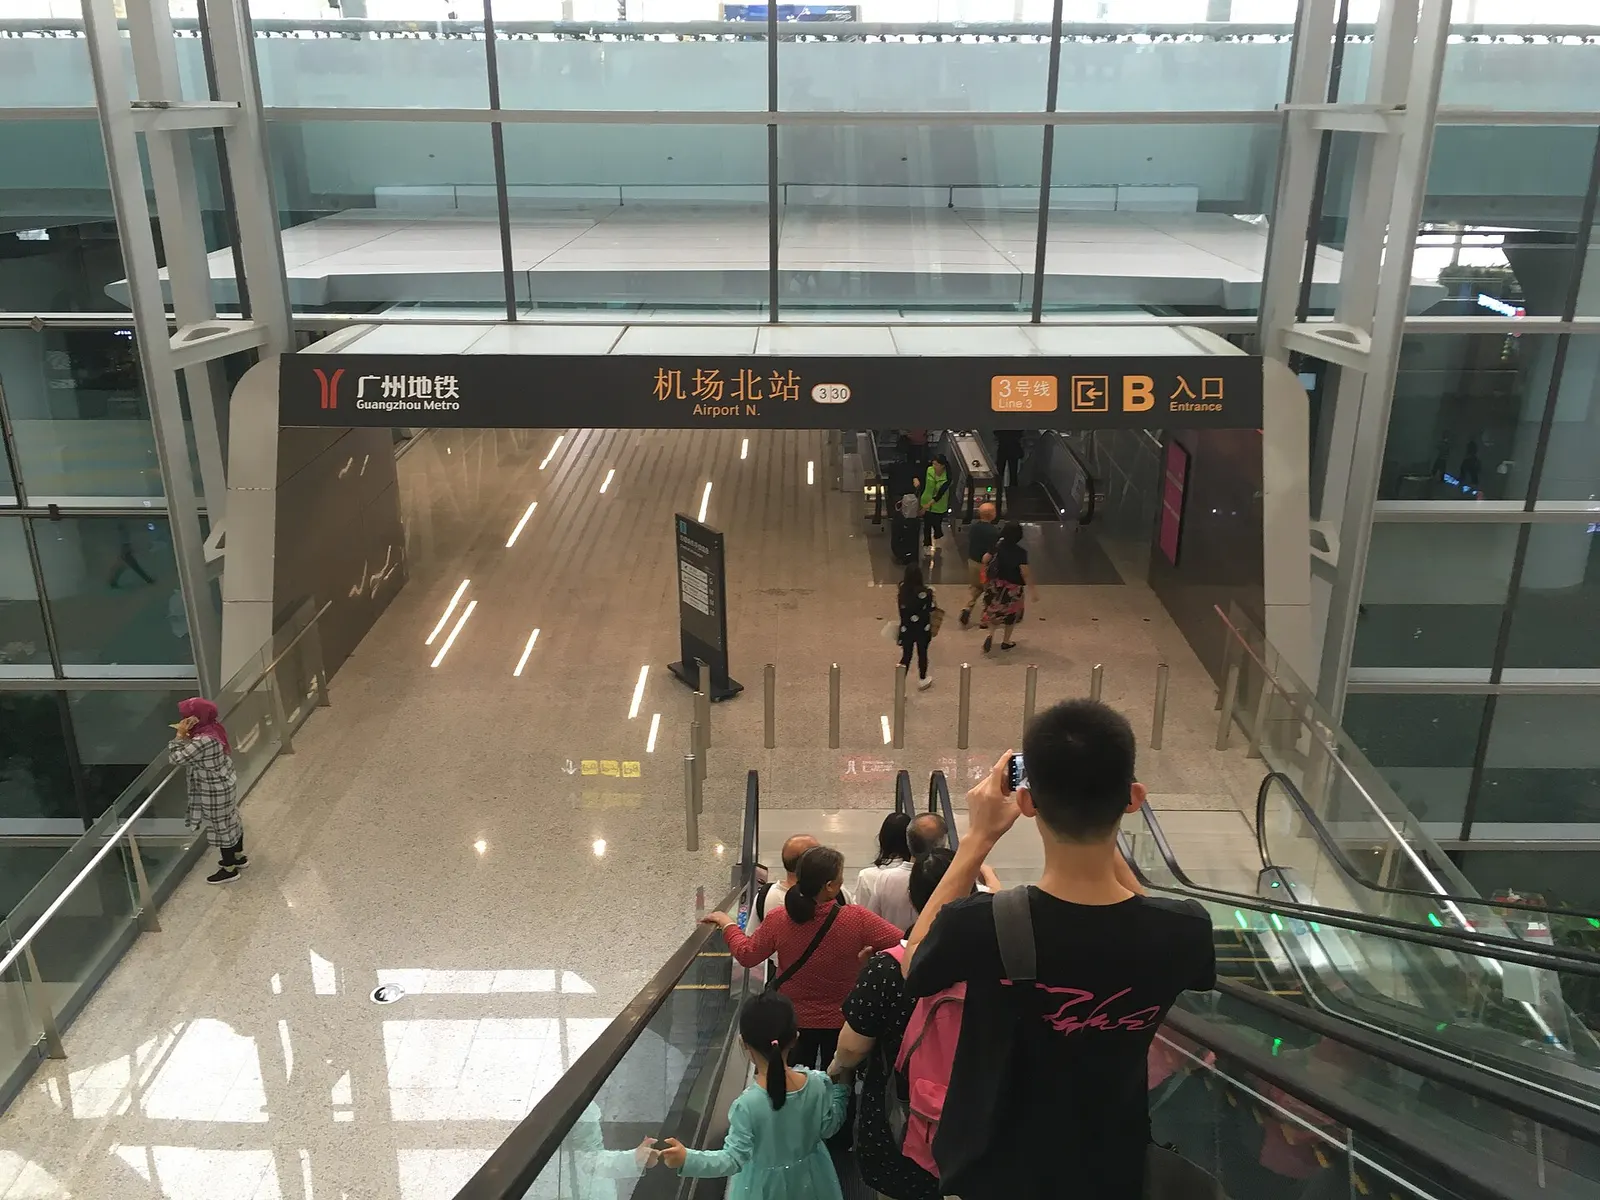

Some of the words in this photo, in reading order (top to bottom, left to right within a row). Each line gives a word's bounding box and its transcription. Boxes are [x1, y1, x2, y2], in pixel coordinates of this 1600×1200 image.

[356, 374, 460, 399] 广州地铁
[652, 367, 801, 401] 机场北站
[999, 379, 1051, 398] 3号线
[1169, 375, 1224, 400] 入口
[819, 387, 828, 400] 3
[831, 387, 848, 400] 30
[1122, 375, 1155, 412] B
[356, 400, 421, 412] Guangzhou
[423, 400, 460, 411] Metro
[693, 404, 740, 418] Airport
[746, 404, 761, 416] N.
[998, 399, 1023, 409] Line
[1024, 399, 1033, 409] 3
[1169, 401, 1223, 412] Entrance
